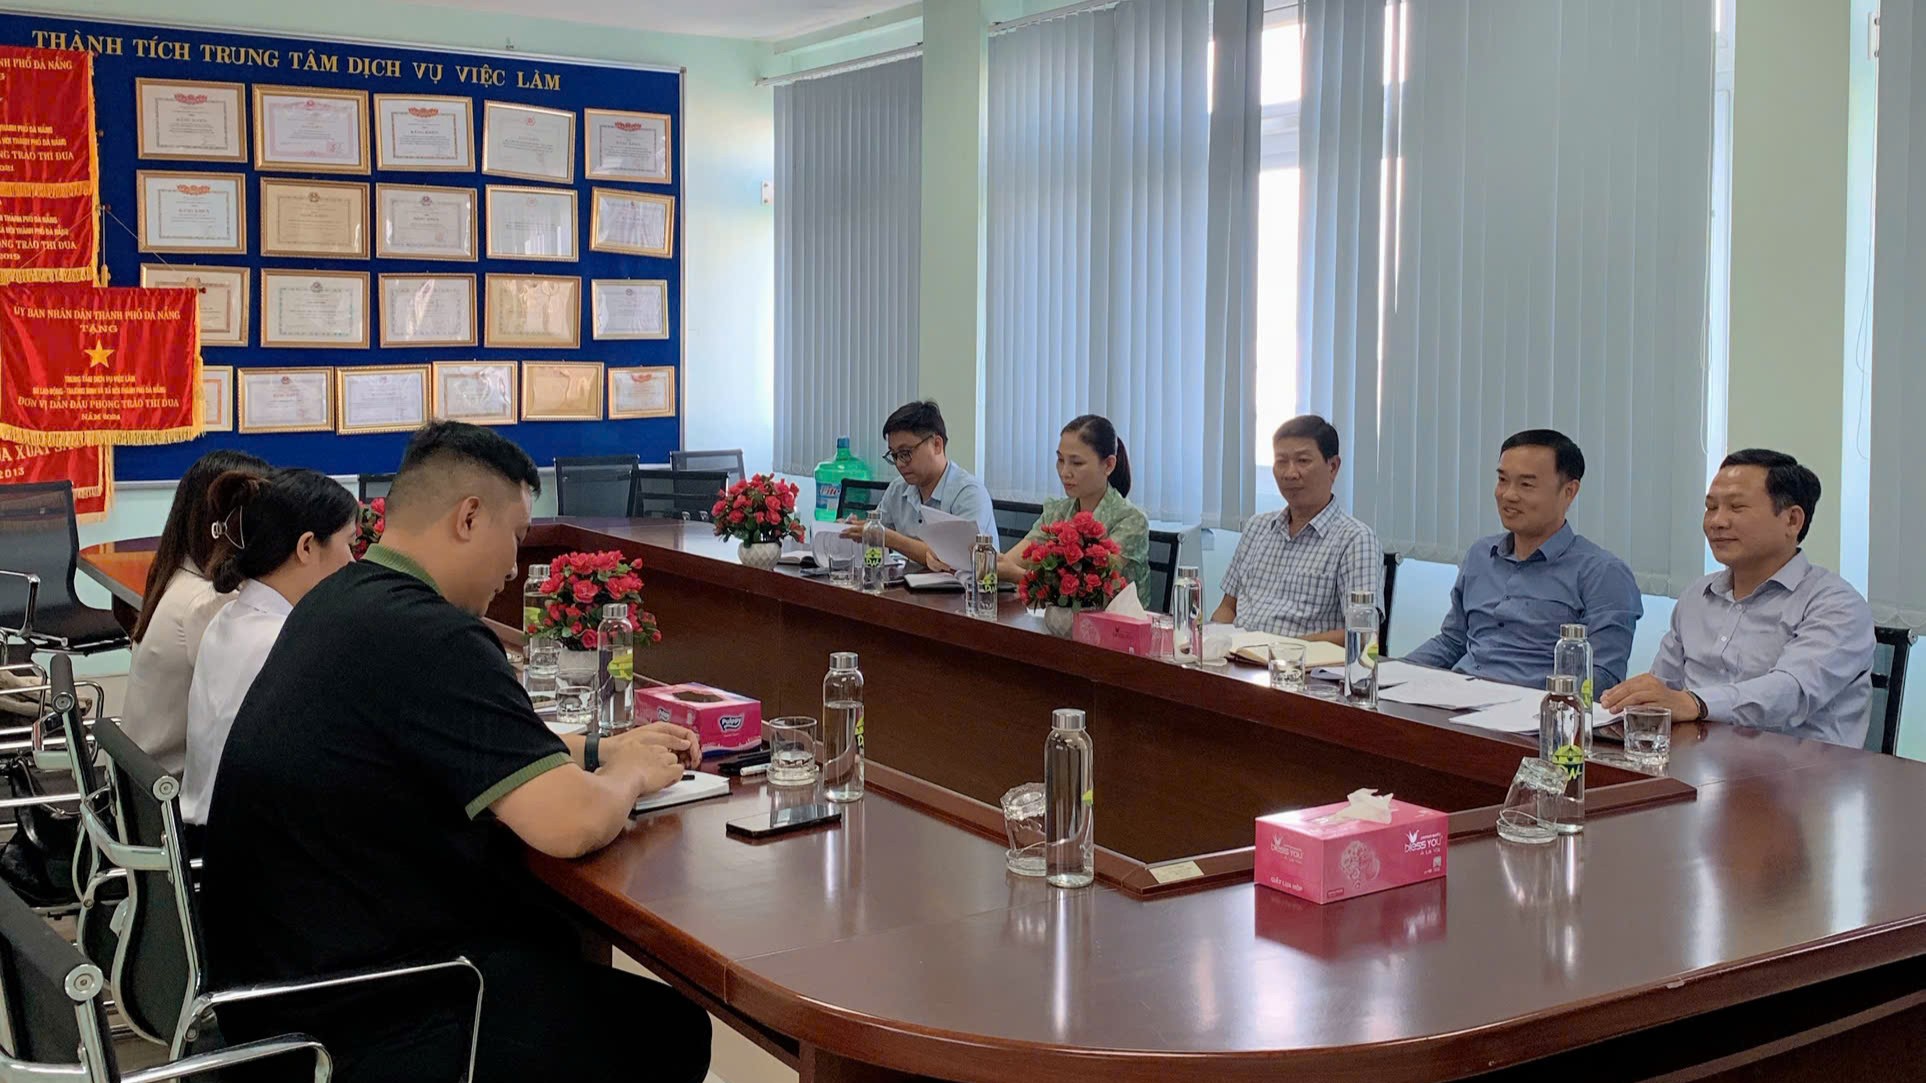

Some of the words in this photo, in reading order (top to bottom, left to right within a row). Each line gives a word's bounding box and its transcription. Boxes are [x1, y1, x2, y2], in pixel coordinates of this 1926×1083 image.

[0, 58, 10, 68] NH
[32, 30, 123, 55] THÀNH
[132, 35, 191, 60] TÍCH
[200, 44, 280, 68] TRUNG
[289, 49, 339, 73] TÂM
[347, 56, 402, 79] DỊCH
[413, 62, 443, 84] VỤ
[456, 63, 506, 87] VIỆC
[516, 69, 561, 91] LÀM
[38, 151, 54, 161] THI
[41, 240, 57, 250] THI
[27, 308, 46, 318] BAN
[47, 307, 72, 319] NHÂN
[125, 307, 143, 320] PHỐ
[90, 399, 120, 409] PHONG
[145, 398, 160, 408] THI
[0, 466, 25, 479] 2013
